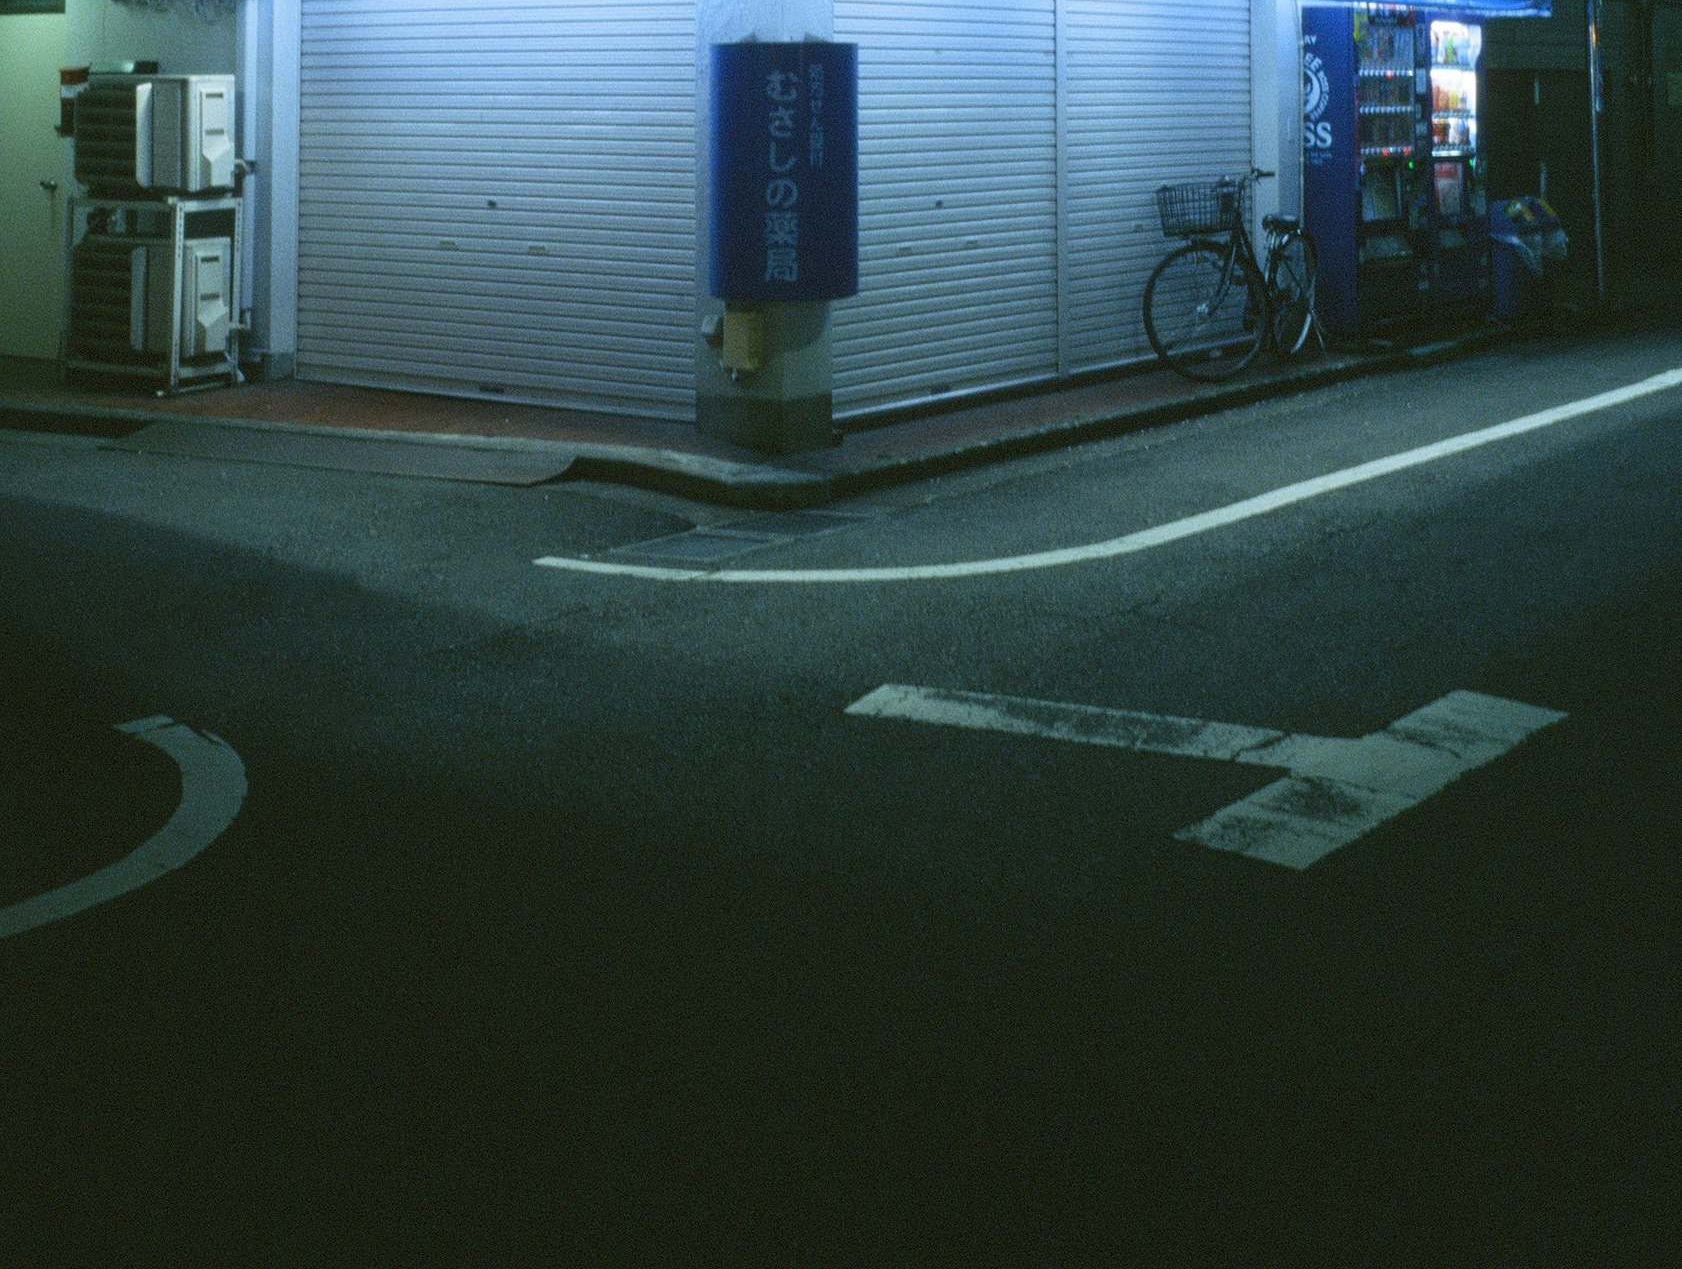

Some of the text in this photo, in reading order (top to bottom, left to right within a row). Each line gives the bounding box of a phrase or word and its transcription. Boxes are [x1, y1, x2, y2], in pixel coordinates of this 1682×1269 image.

[765, 69, 798, 282] むさしの薬局
[1303, 122, 1332, 148] SS
